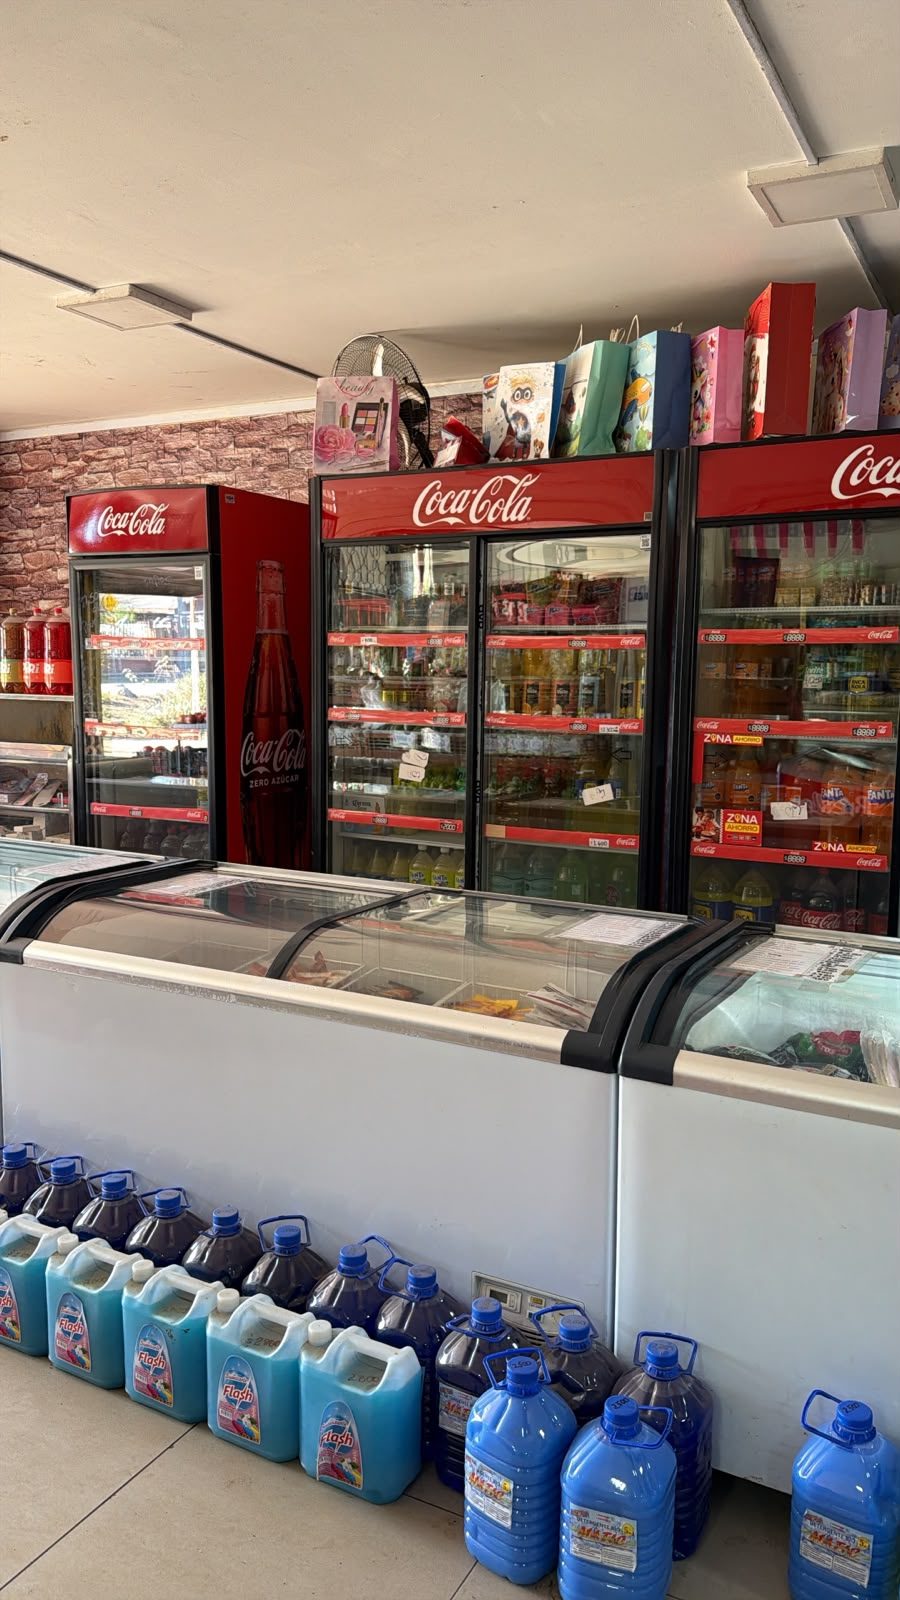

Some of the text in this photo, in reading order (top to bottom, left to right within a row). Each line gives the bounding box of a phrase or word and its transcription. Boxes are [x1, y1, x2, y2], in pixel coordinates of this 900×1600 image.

[339, 378, 375, 396] beauty
[412, 473, 542, 527] Coca-Cola
[97, 503, 170, 537] Coca-Cola
[240, 729, 306, 777] Coca-Cola
[249, 778, 269, 788] ZERO
[59, 1317, 84, 1334] Flash
[138, 1351, 166, 1369] Flash
[223, 1384, 253, 1402] Flash
[319, 1430, 353, 1448] Flash
